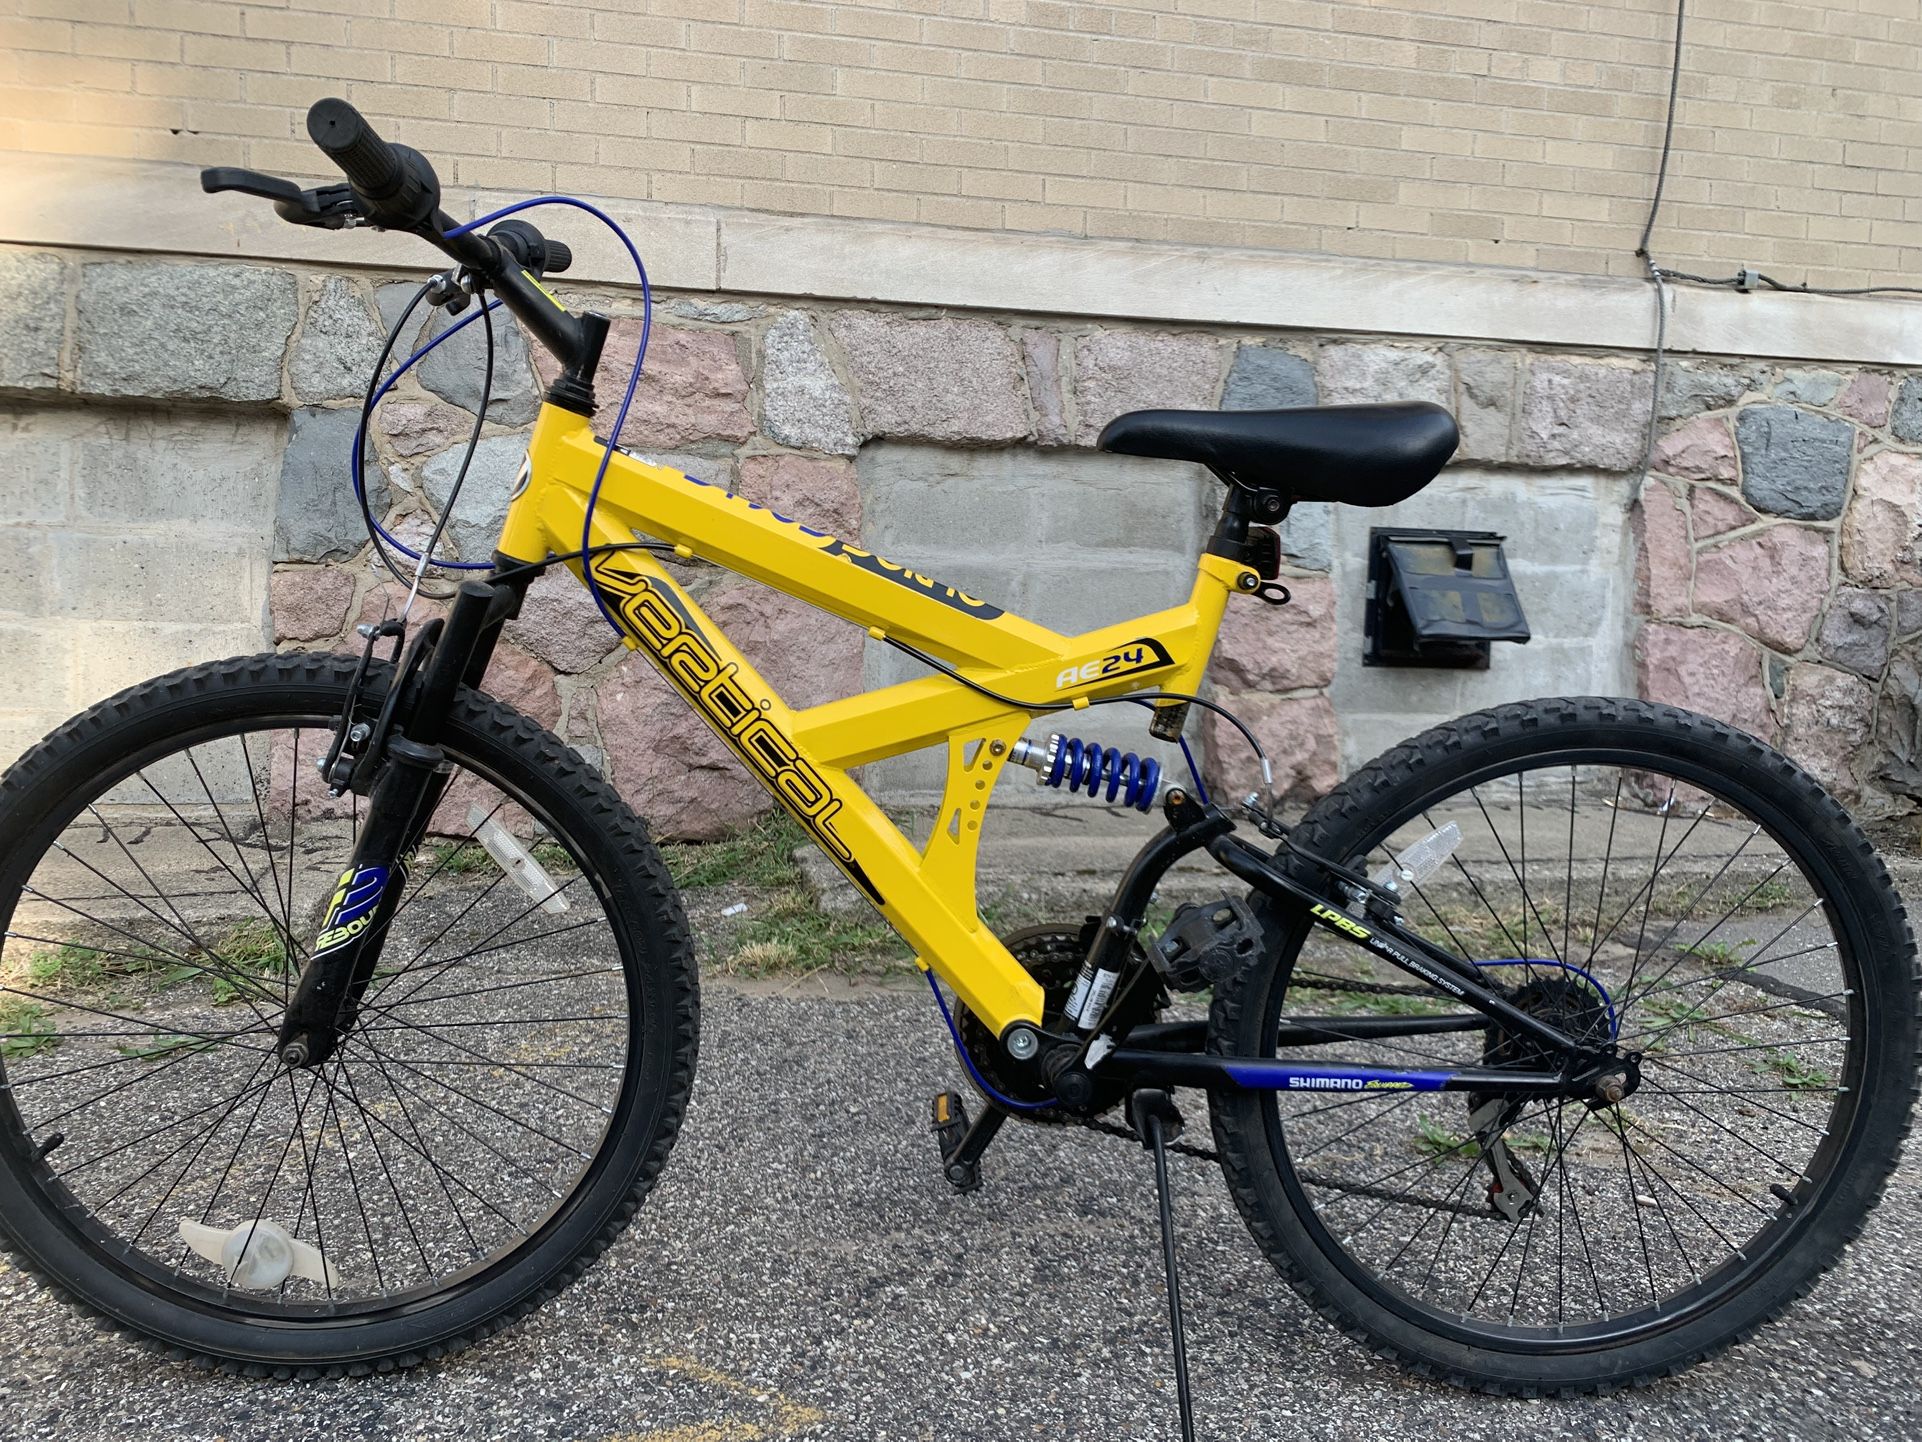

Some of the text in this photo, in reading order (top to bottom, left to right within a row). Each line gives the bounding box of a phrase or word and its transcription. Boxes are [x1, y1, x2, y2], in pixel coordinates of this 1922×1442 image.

[1056, 647, 1144, 689] AE24
[1310, 903, 1371, 939] LPBS
[1392, 950, 1409, 967] PULL
[1408, 961, 1438, 982] BRAKING
[1436, 977, 1465, 996] SYSTEM
[1289, 1076, 1363, 1090] SHIMANO
